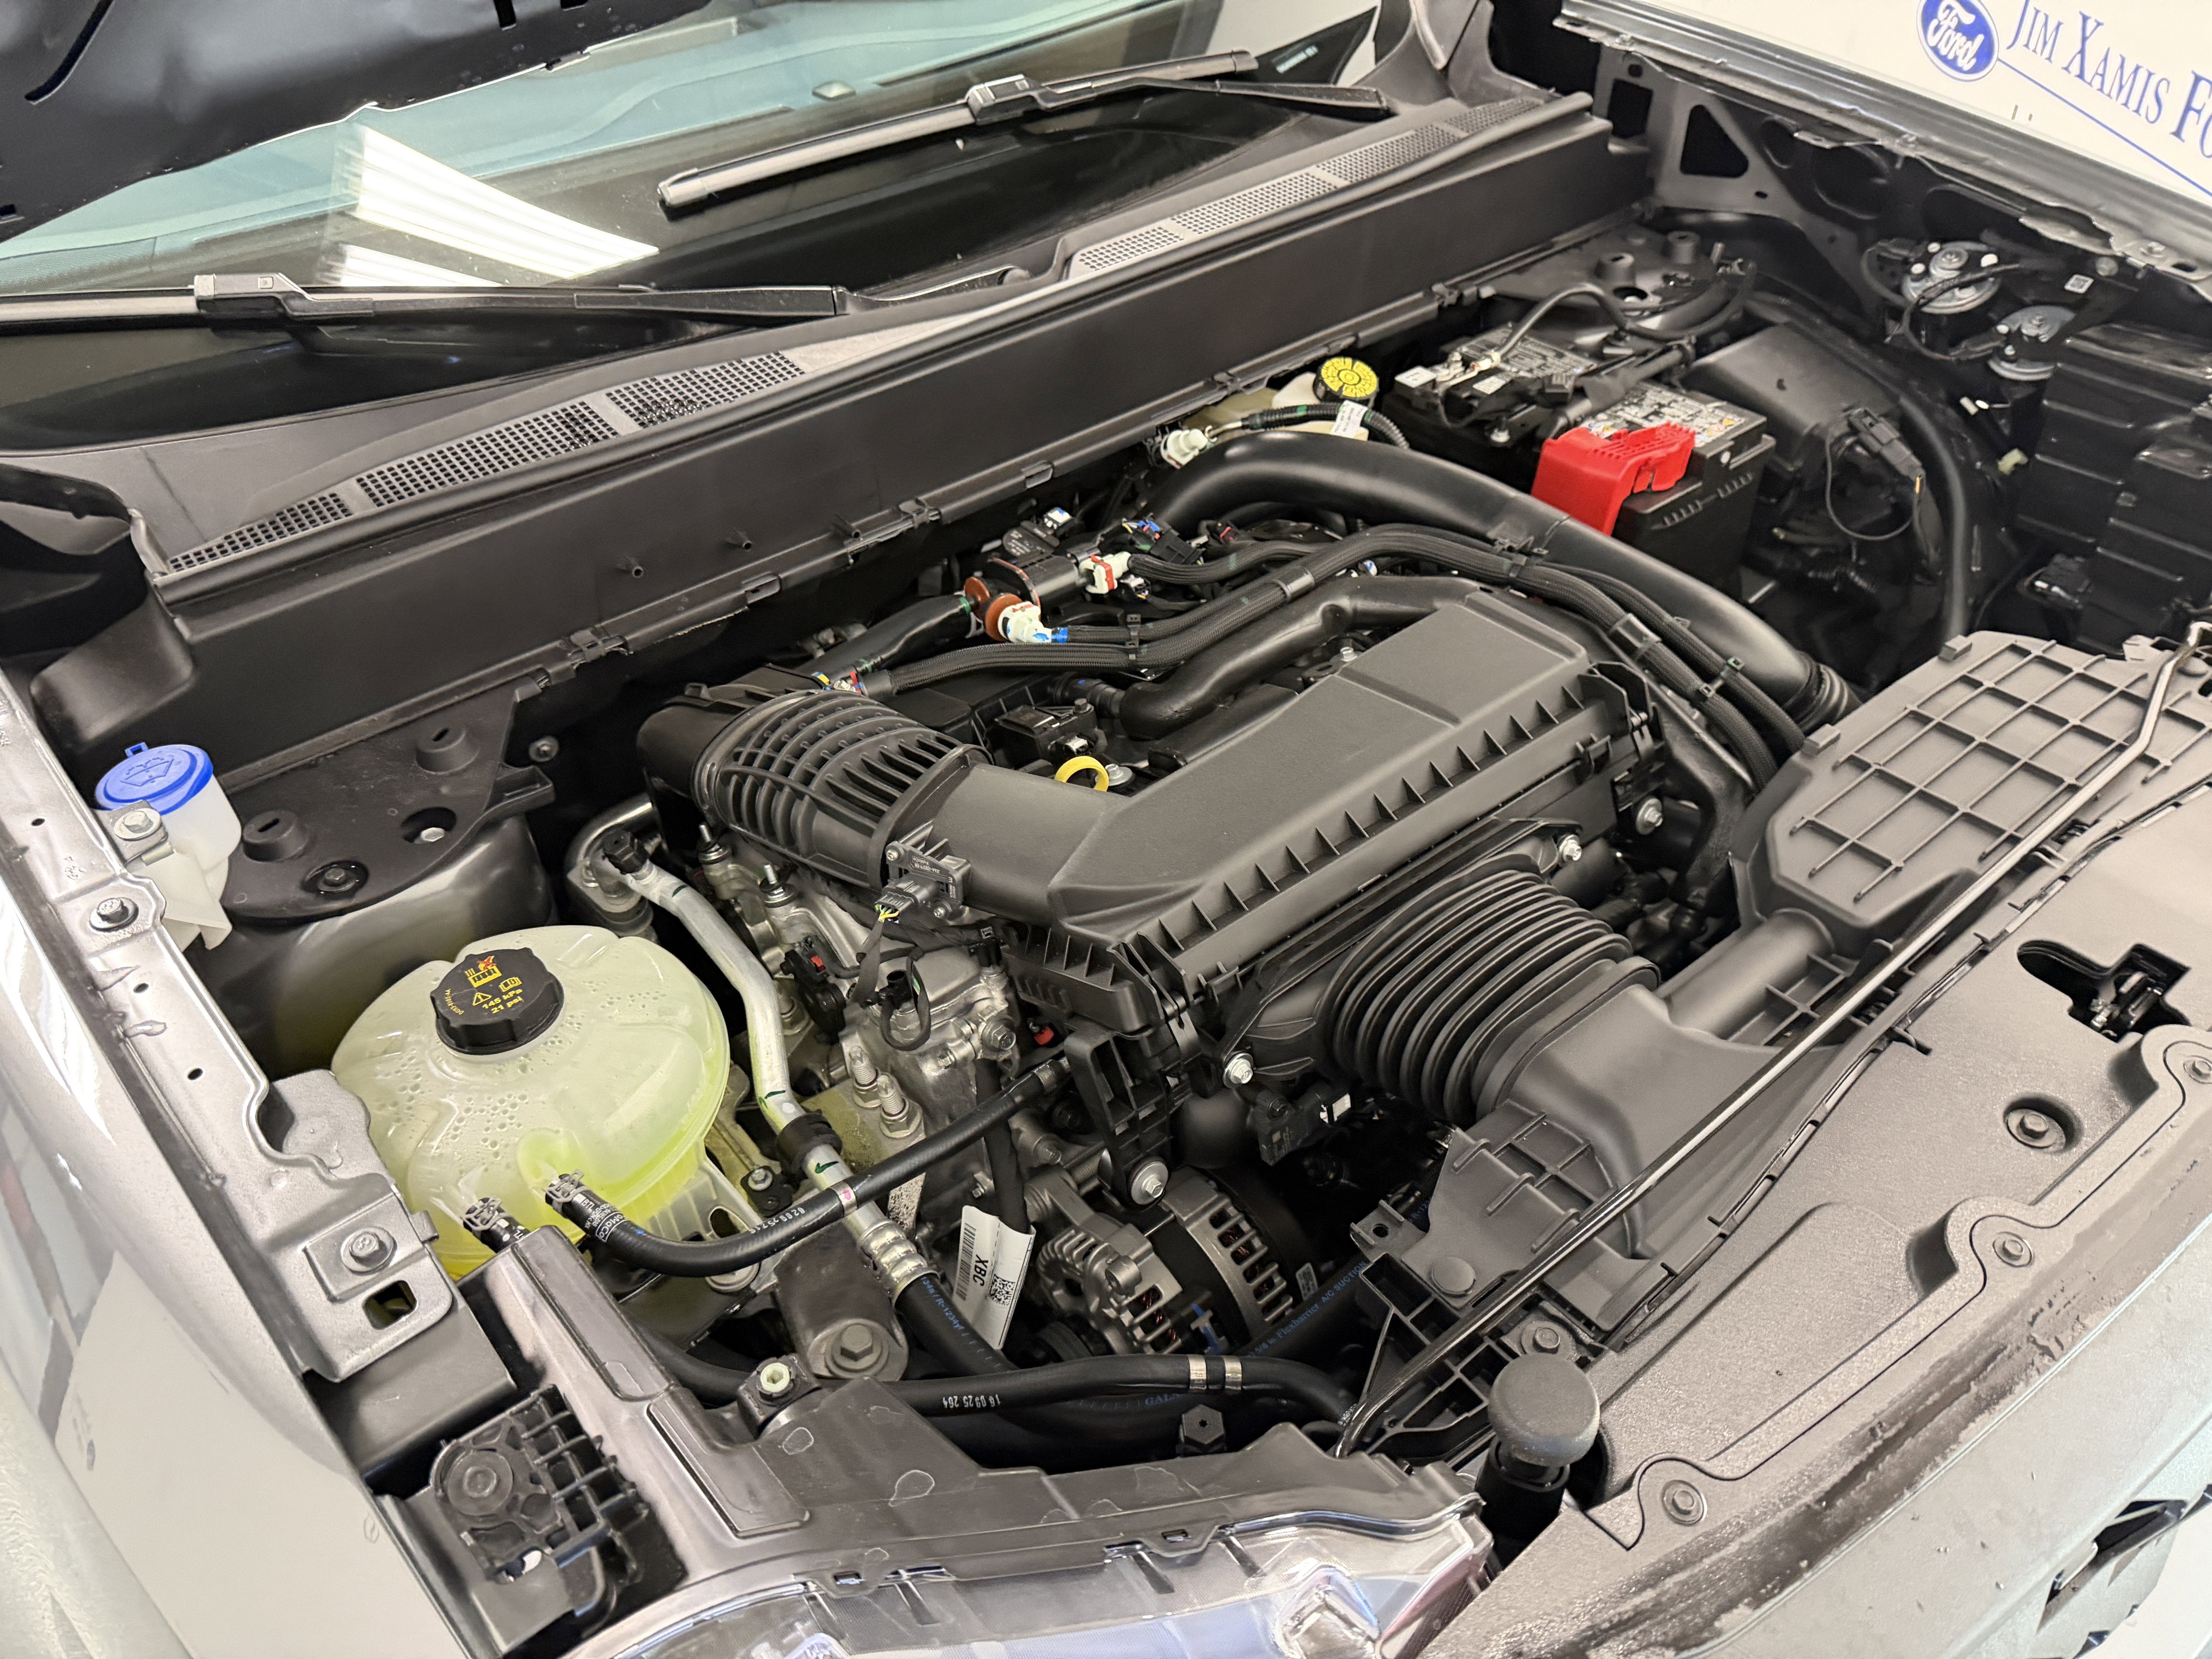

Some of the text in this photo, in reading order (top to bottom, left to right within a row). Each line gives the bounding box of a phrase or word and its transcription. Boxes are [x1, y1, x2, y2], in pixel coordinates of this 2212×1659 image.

[1927, 0, 1985, 71] Ford
[482, 997, 501, 1009] 145
[491, 996, 523, 1014] 21 psi
[599, 1214, 624, 1238] oMoCo
[973, 1254, 989, 1287] XBC
[1334, 1261, 1368, 1291] SUCTION
